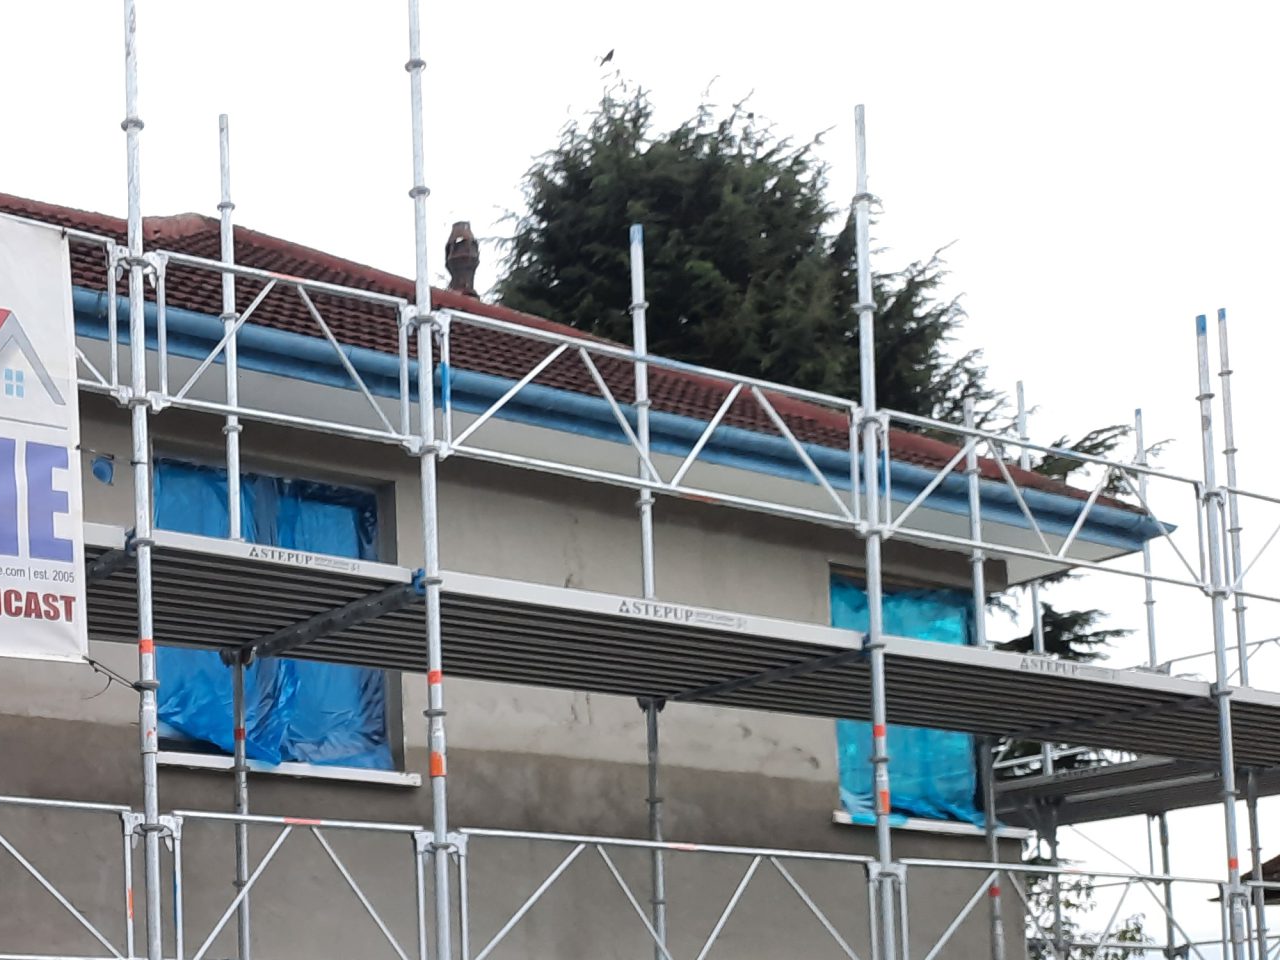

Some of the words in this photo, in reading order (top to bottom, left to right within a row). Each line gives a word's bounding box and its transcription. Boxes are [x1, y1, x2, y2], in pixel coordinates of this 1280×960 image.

[260, 548, 313, 565] STEPUP
[33, 568, 50, 581] est.
[52, 569, 75, 583] 2005
[632, 602, 694, 622] STEPUP
